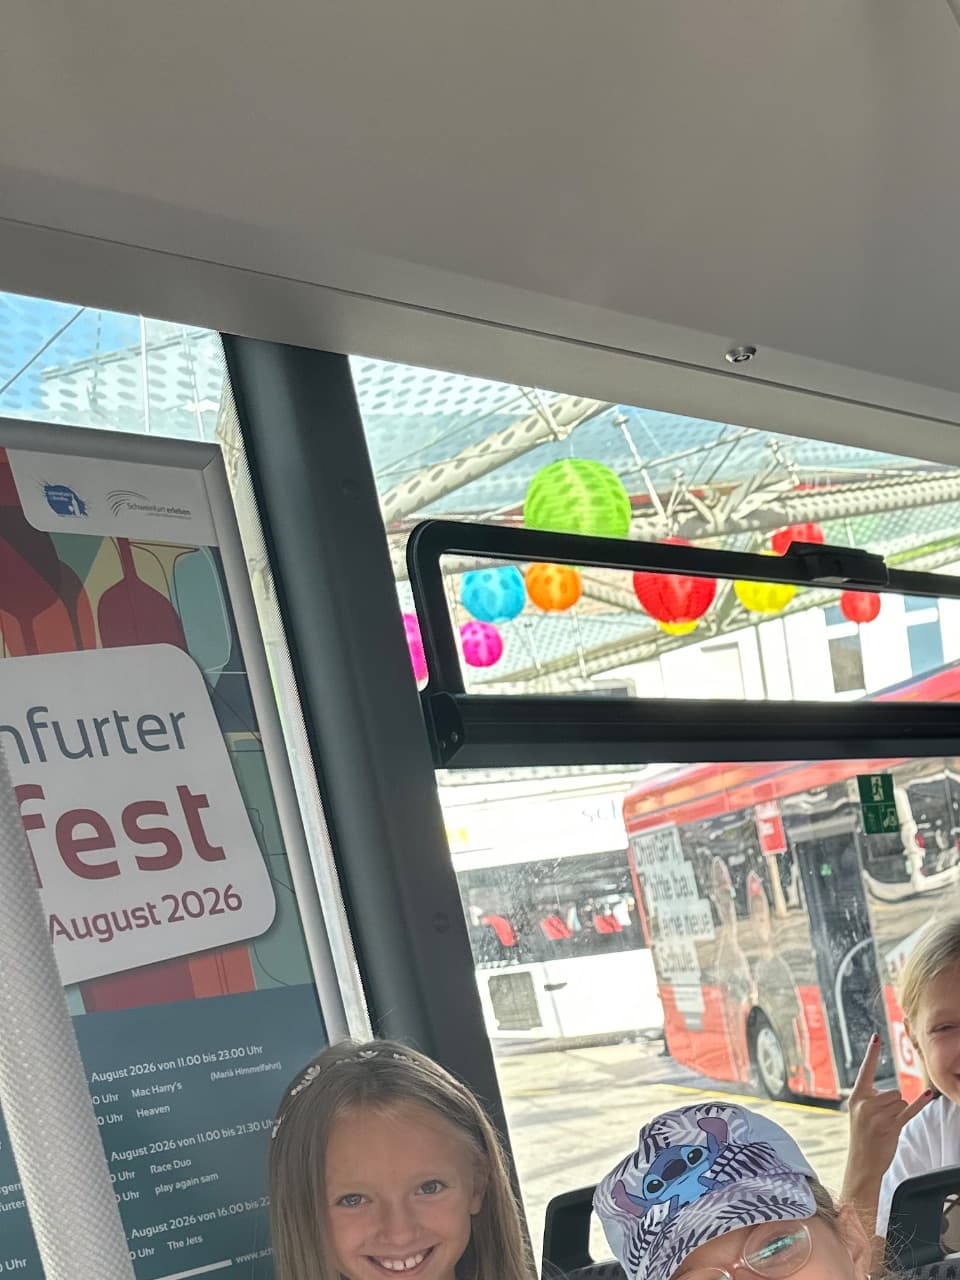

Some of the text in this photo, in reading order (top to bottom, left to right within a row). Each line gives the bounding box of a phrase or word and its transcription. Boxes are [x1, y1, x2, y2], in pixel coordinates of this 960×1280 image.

[14, 783, 226, 889] fest
[49, 884, 243, 943] August 2026
[91, 1045, 263, 1083] August 2026 von 11.00 bis 23.00 Uhr
[102, 1093, 119, 1104] Uhr
[130, 1088, 151, 1098] Mac
[151, 1081, 183, 1095] Harry's
[106, 1113, 124, 1124] Uhr
[135, 1105, 171, 1118] Heaven
[111, 1119, 275, 1162] August 2026 von 11.00 bis 21.30 Uh
[118, 1170, 136, 1181] Uhr
[149, 1163, 173, 1174] Race
[173, 1159, 192, 1169] Duo
[122, 1190, 140, 1201] Uhr
[154, 1182, 174, 1196] play
[175, 1177, 200, 1190] again
[200, 1173, 219, 1184] sam
[131, 1223, 168, 1239] August
[169, 1215, 196, 1230] 2026
[197, 1211, 216, 1222] von
[217, 1203, 244, 1217] 16.00
[244, 1199, 259, 1210] bis
[138, 1247, 155, 1258] Uhr
[167, 1241, 184, 1251] The
[186, 1235, 203, 1246] Jets
[5, 1257, 28, 1271] Uhr
